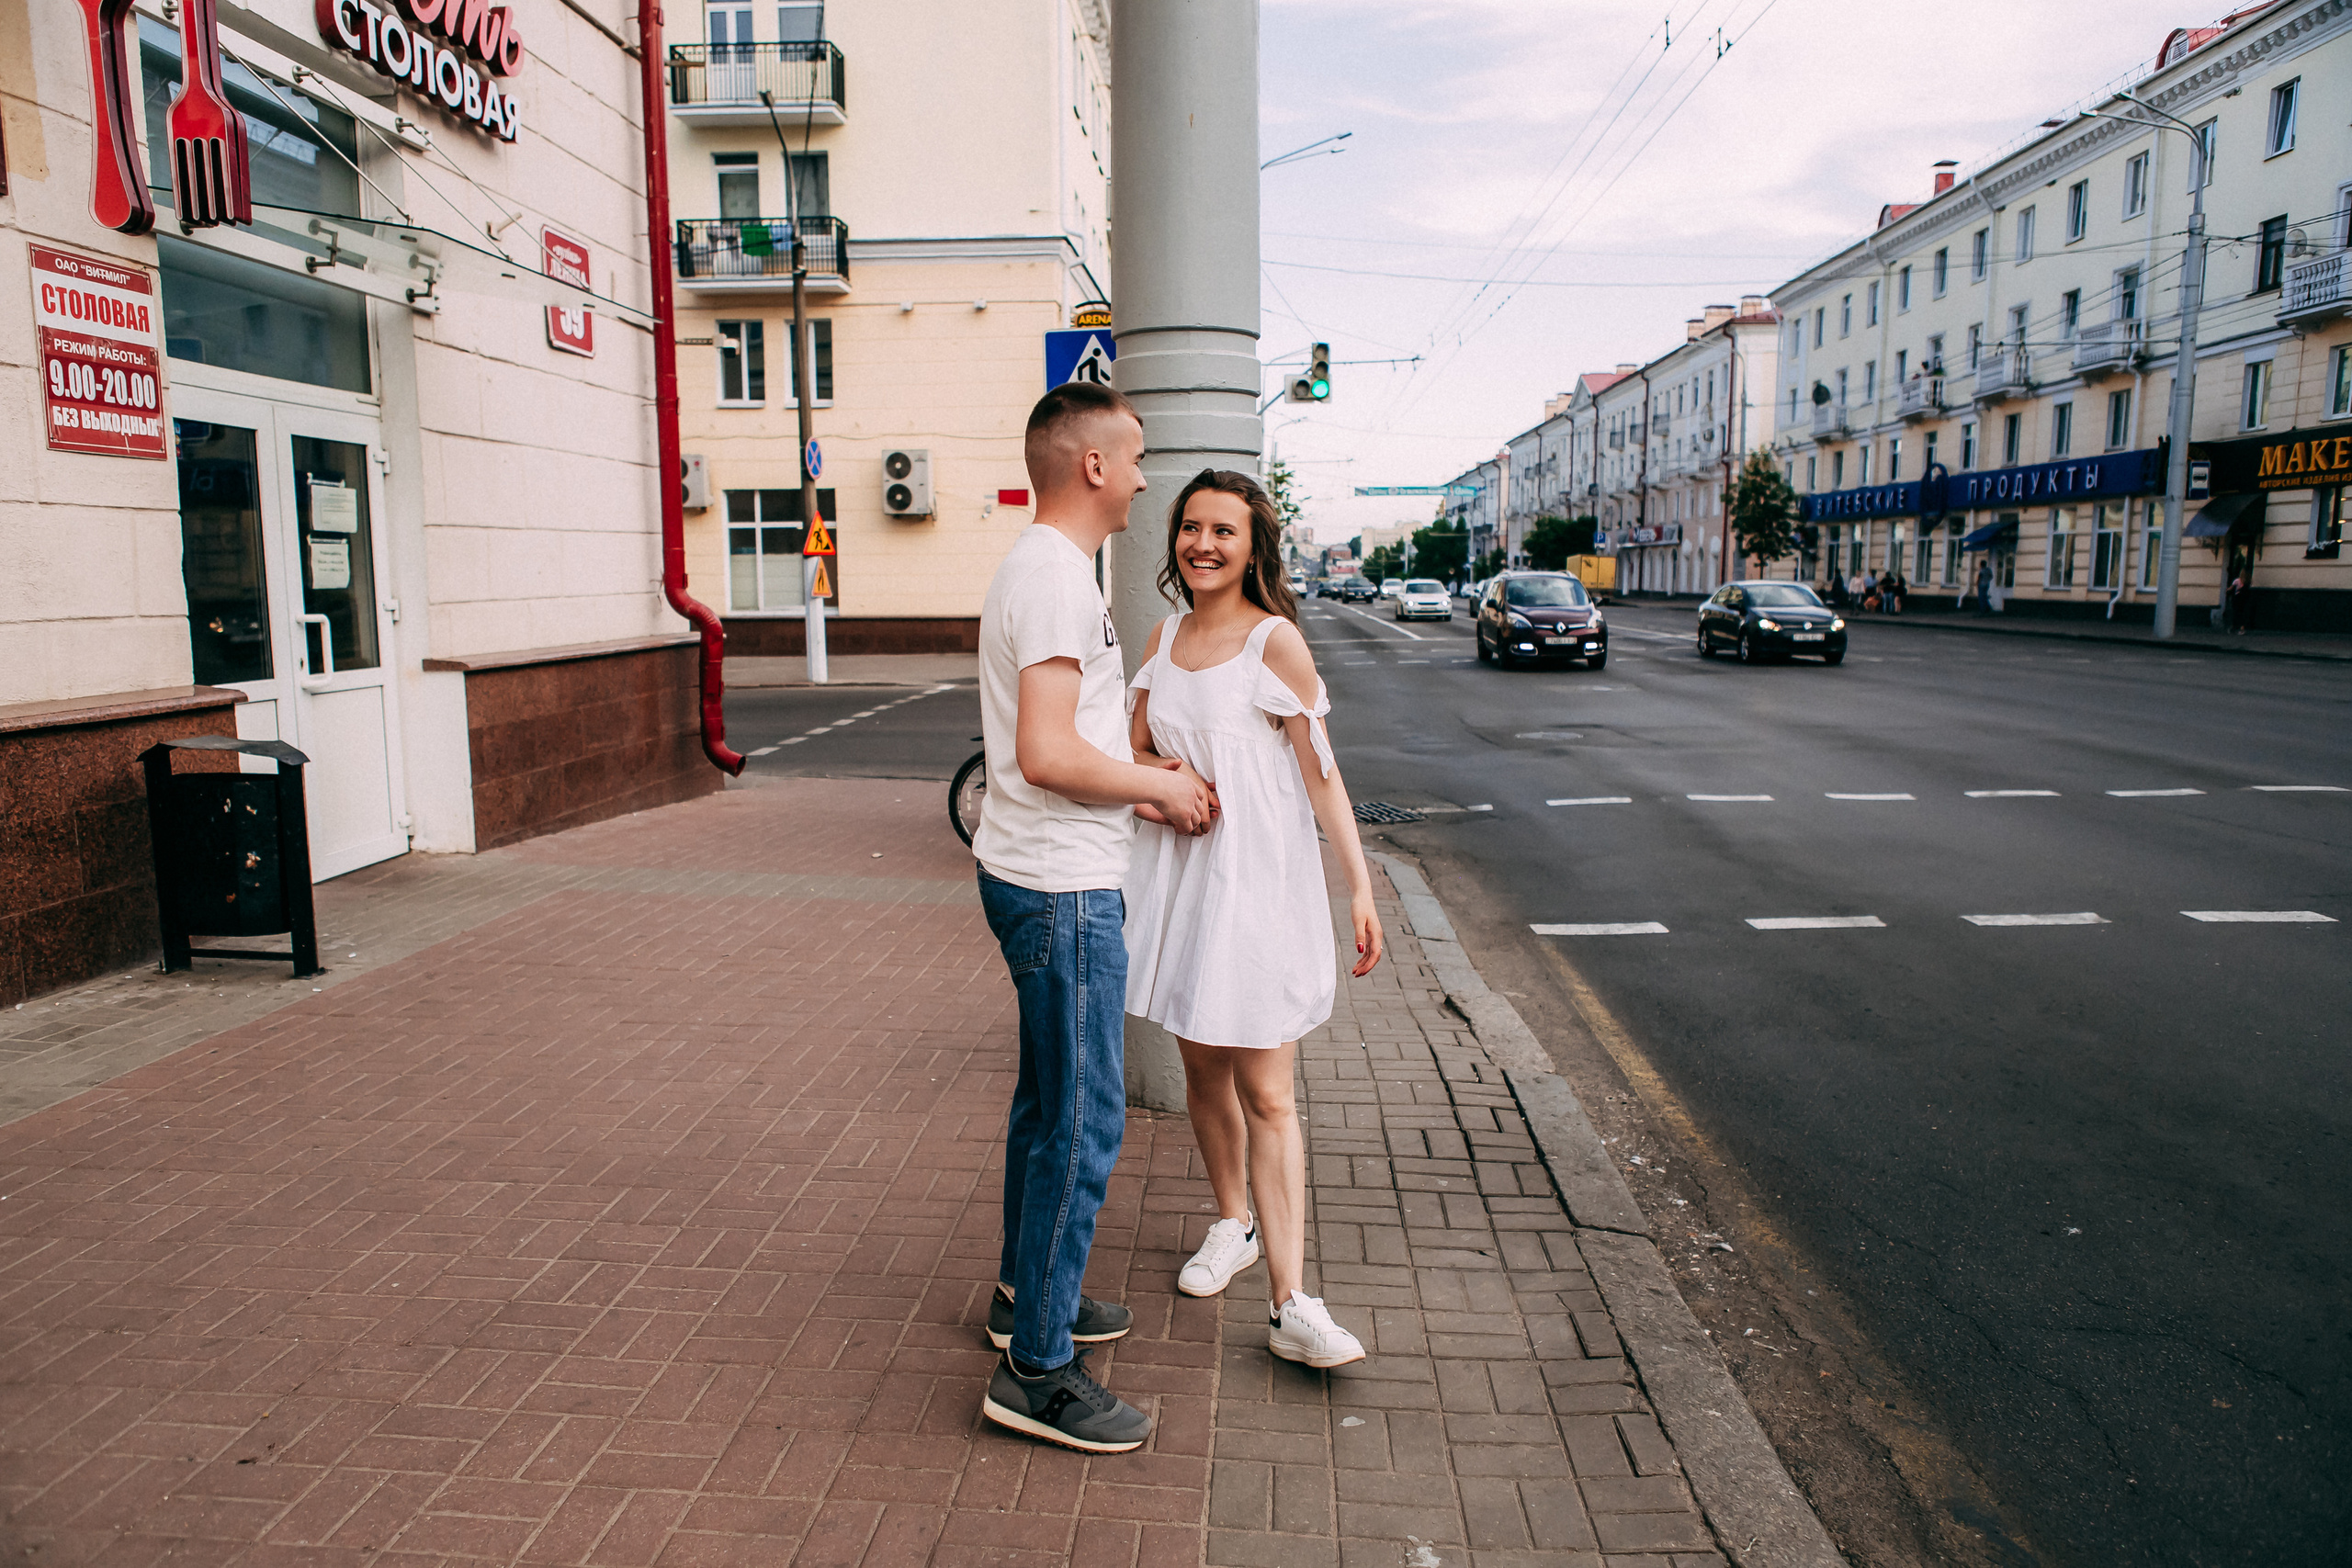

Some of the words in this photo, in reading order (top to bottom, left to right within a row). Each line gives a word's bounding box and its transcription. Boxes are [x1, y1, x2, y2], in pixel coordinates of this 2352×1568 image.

[334, 0, 521, 143] СТОЛОВАЯ
[55, 258, 79, 273] ОАО
[41, 283, 151, 333] СТОЛОВАЯ
[54, 338, 96, 357] РЕЖИМ
[98, 346, 147, 366] РАБОТЫ:
[50, 359, 156, 410] 9.00-20.00
[52, 406, 79, 428] БЕЗ
[81, 409, 160, 437] ВЫХОДНЫХ
[1969, 464, 2098, 501] ПРОДУКТЫ
[2259, 478, 2301, 489] АВТОРСКИЕ
[2303, 474, 2340, 485] ИЗДЕЛИЯ
[1817, 488, 1905, 515] ВИТЕБСКИЕ
